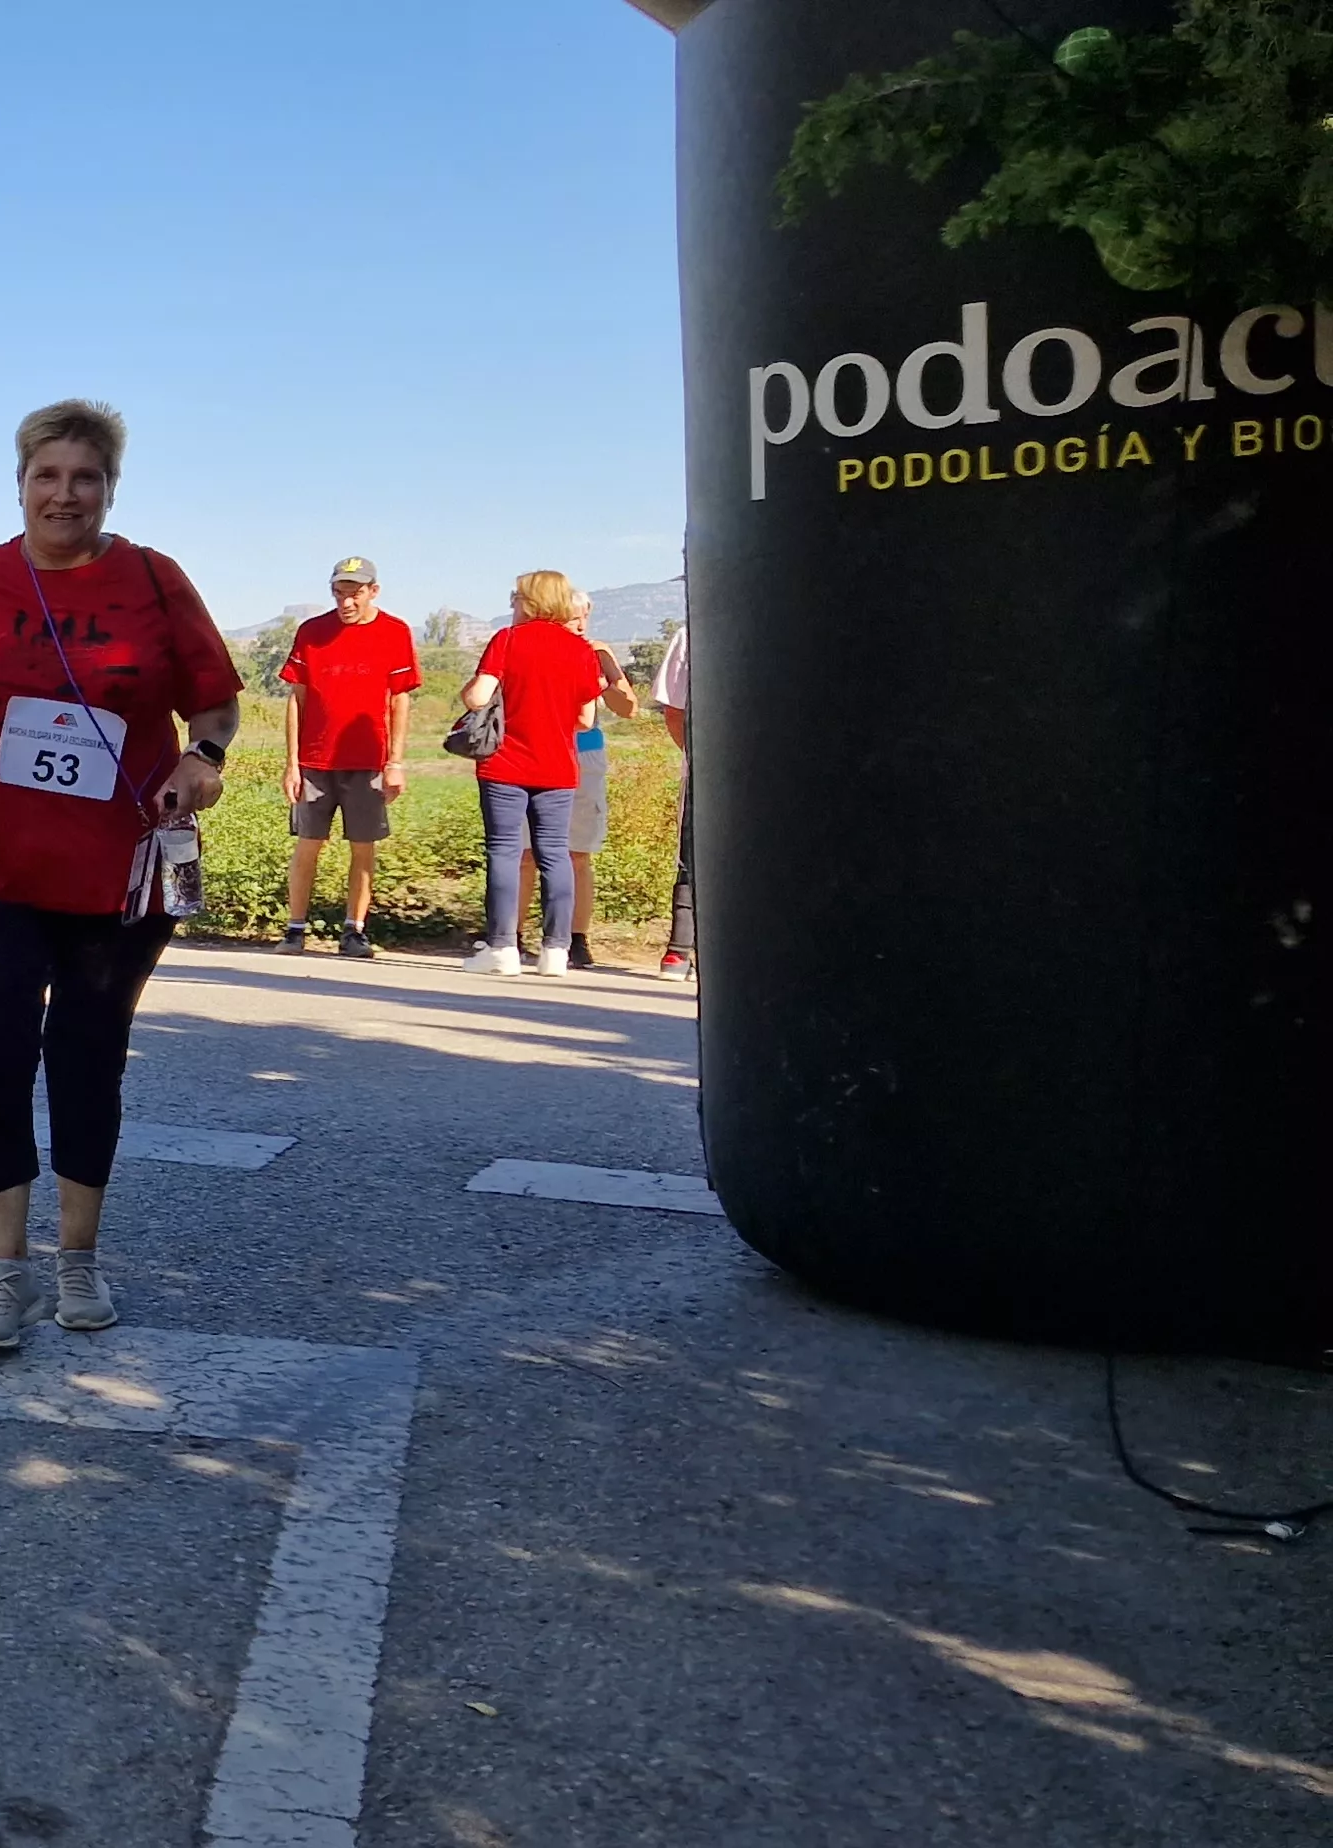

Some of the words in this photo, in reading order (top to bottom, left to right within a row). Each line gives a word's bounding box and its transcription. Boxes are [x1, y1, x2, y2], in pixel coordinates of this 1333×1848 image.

[837, 423, 1152, 493] PODOLOGÍA
[1175, 424, 1208, 461] Y
[1233, 414, 1333, 458] BIO
[32, 750, 80, 787] 53
